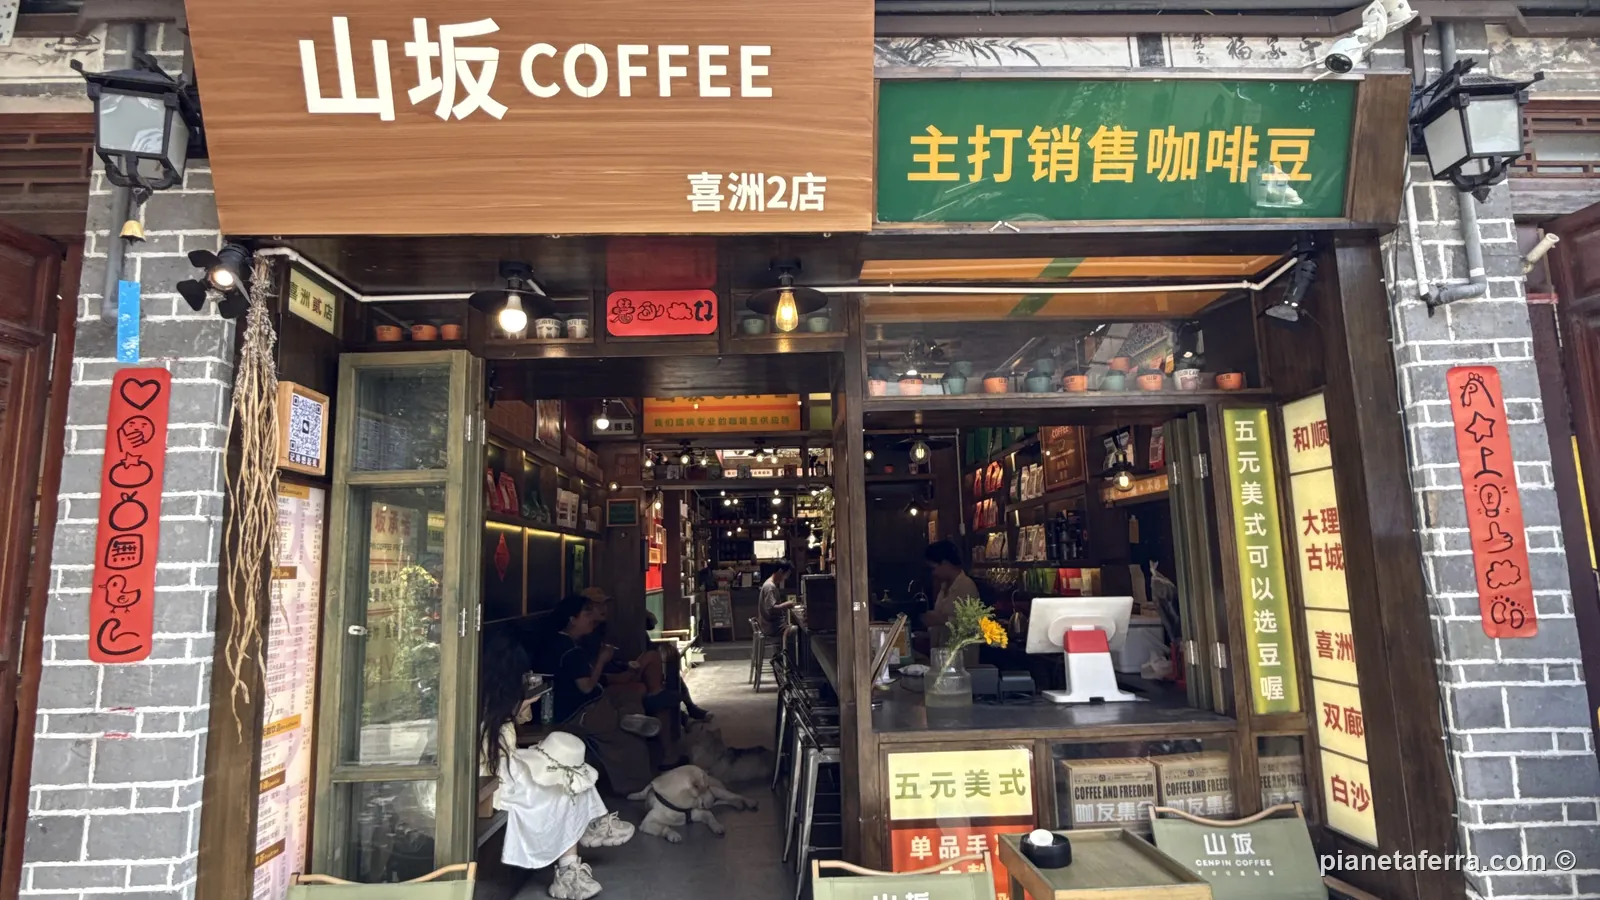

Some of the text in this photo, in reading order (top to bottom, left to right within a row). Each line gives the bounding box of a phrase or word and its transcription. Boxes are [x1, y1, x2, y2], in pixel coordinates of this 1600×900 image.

[299, 16, 773, 121] 山坂 COFFEE
[907, 123, 1316, 185] 主打销售咖啡豆
[686, 171, 828, 213] 喜洲2店
[1292, 420, 1331, 453] 和顺
[1302, 507, 1341, 537] 大理
[1233, 418, 1286, 702] 五元美式可以选豆喔
[1305, 542, 1345, 571] 古城
[1315, 630, 1356, 663] 喜洲
[1323, 701, 1364, 739] 双廊
[895, 767, 1027, 800] 五元美式
[1074, 783, 1154, 800] COFFEE AND FREEDOM
[1165, 781, 1191, 796] COFFEE
[1192, 780, 1206, 794] AND
[1331, 774, 1371, 812] 白沙
[910, 834, 1000, 861] 单品手
[1203, 832, 1256, 855] 山坂
[1235, 859, 1272, 867] COFFEE
